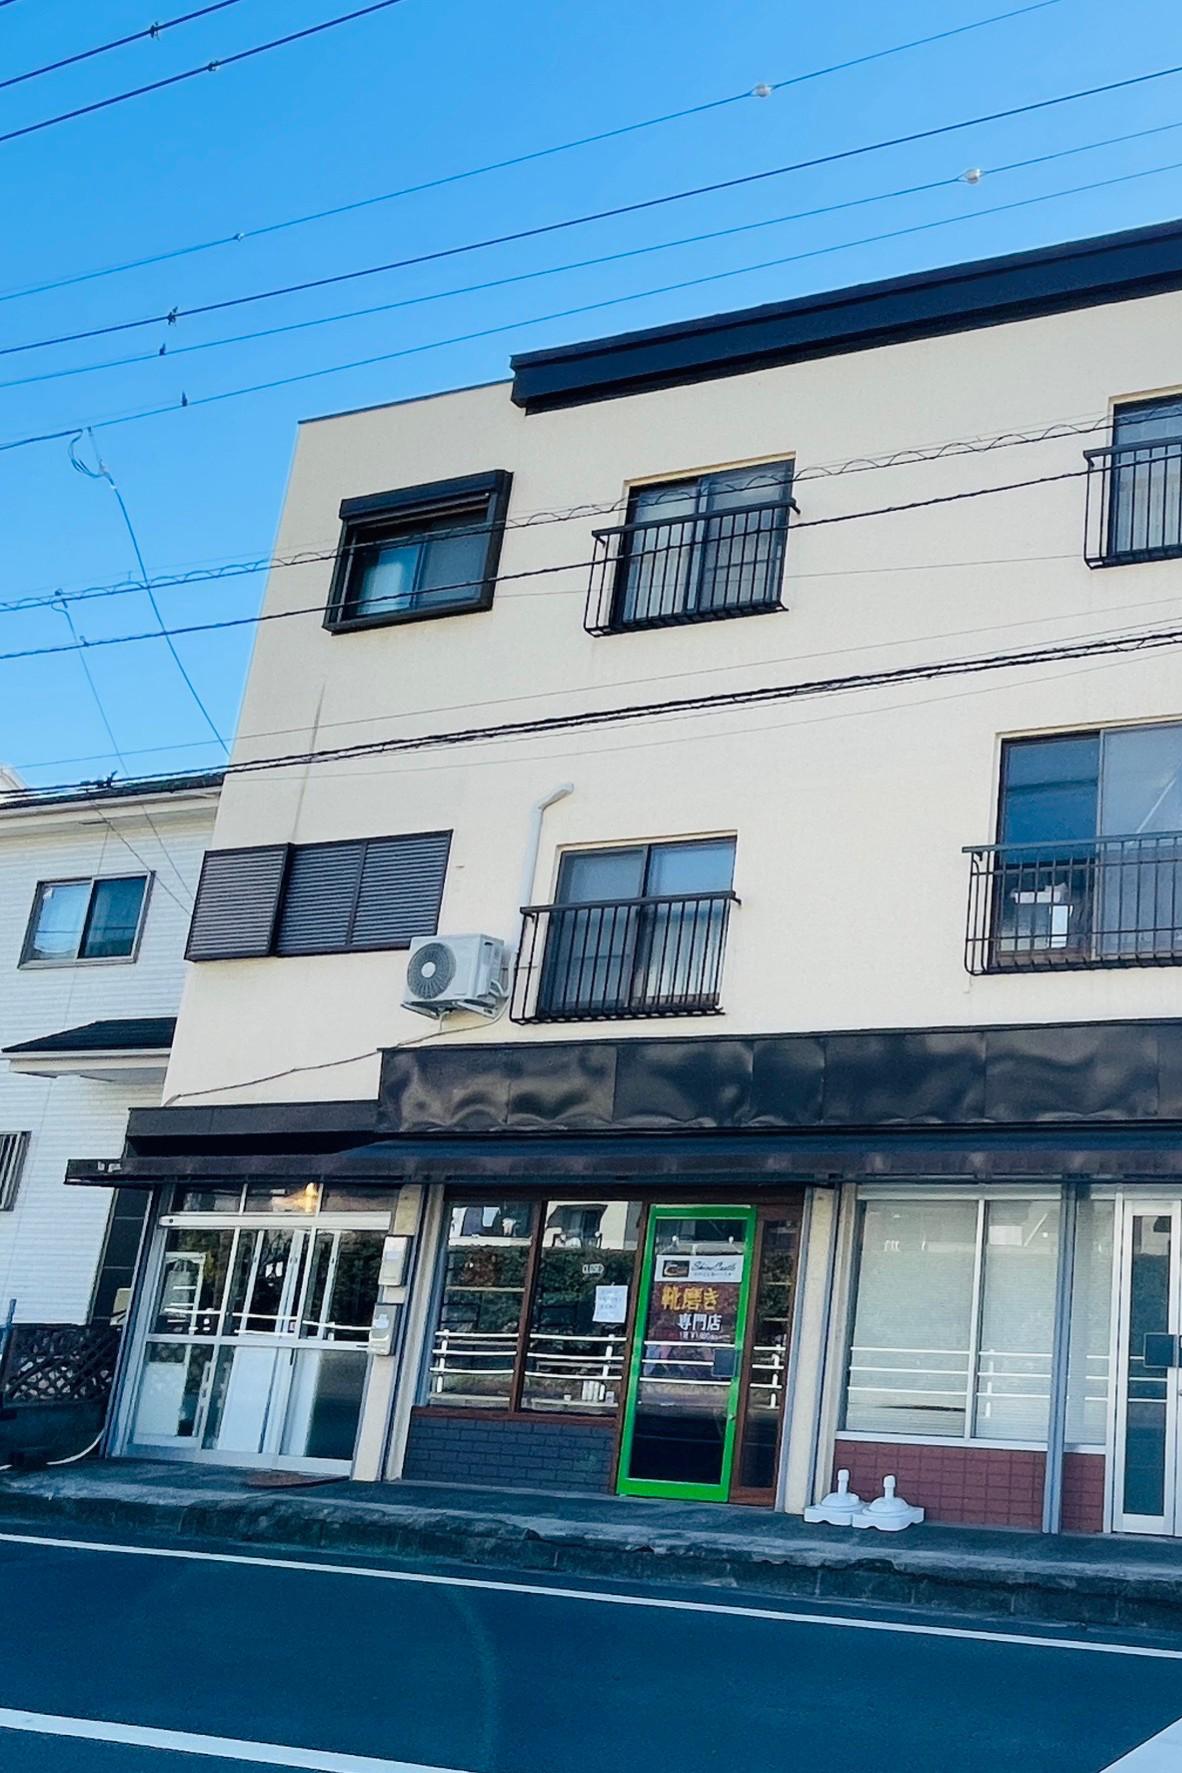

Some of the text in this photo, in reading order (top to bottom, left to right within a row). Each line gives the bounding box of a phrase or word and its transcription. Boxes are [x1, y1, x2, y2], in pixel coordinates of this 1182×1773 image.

[661, 1286, 719, 1311] 靴磨き
[677, 1313, 723, 1331] 専門店
